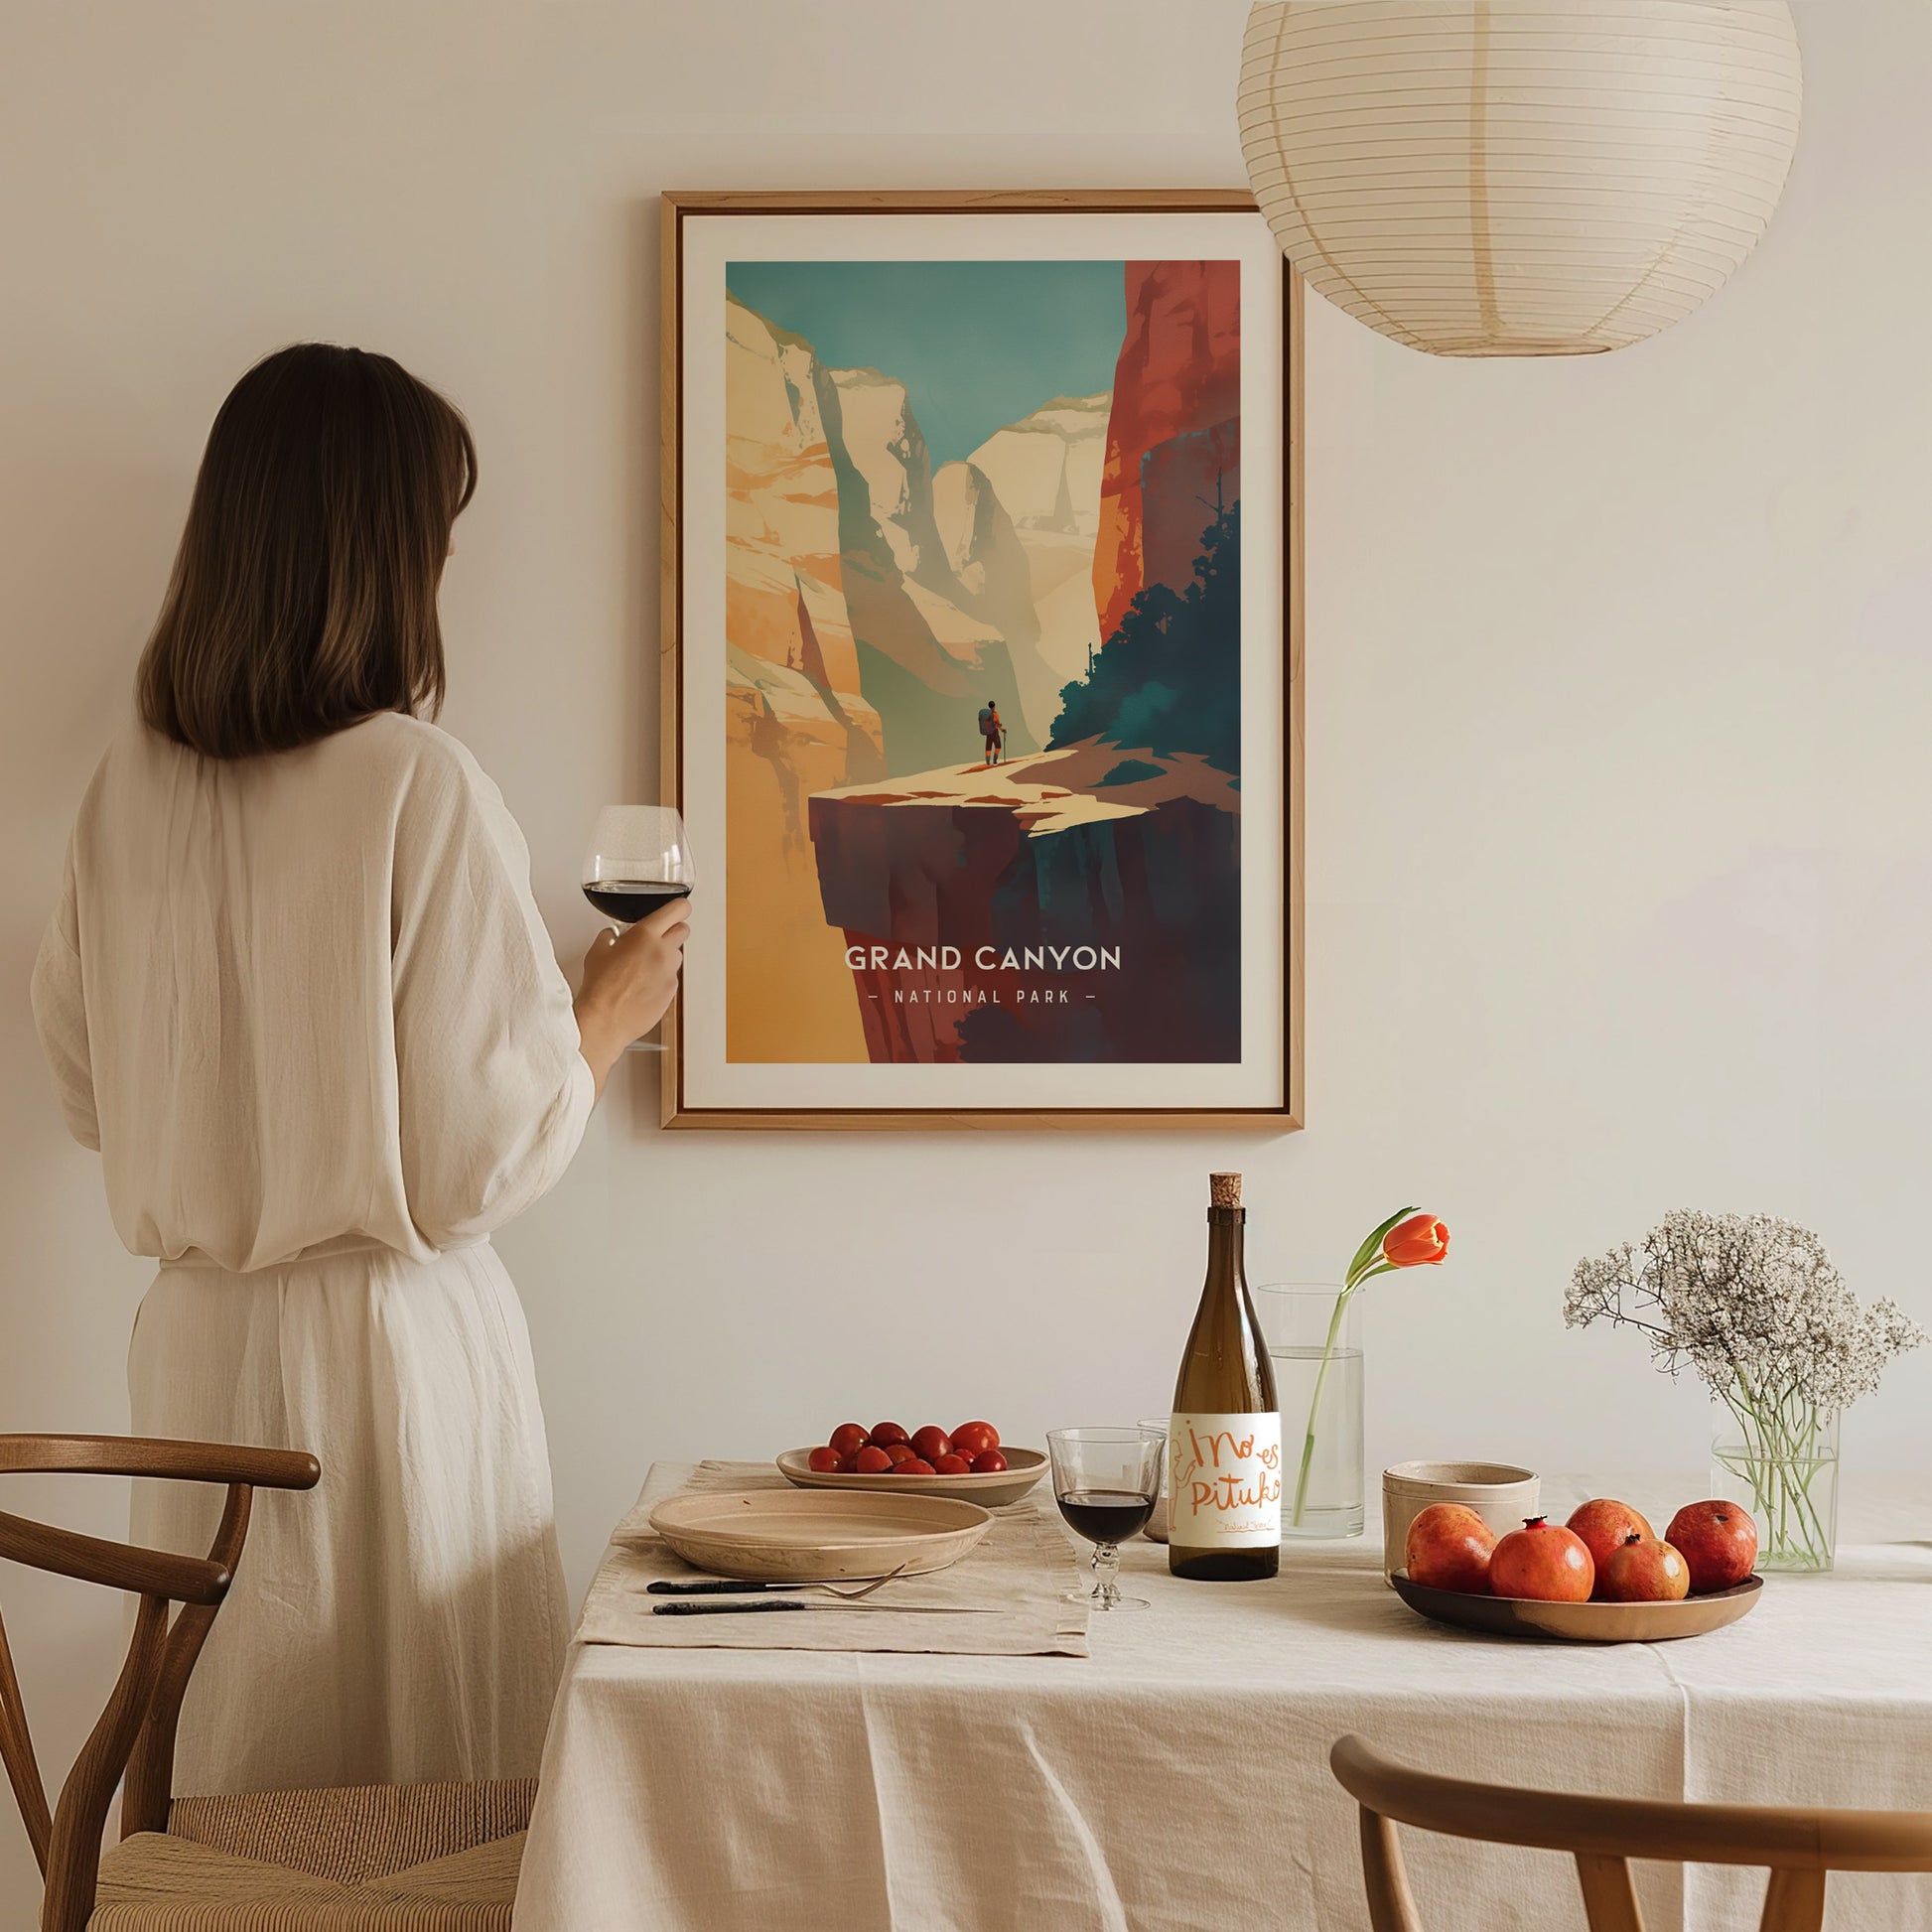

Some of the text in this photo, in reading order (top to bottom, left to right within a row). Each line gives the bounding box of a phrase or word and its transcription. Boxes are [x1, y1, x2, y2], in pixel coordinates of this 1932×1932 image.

[844, 945, 1121, 970] GRAND CANYON
[895, 990, 1068, 1004] NATIONAL PARK
[1256, 1444, 1279, 1469] es
